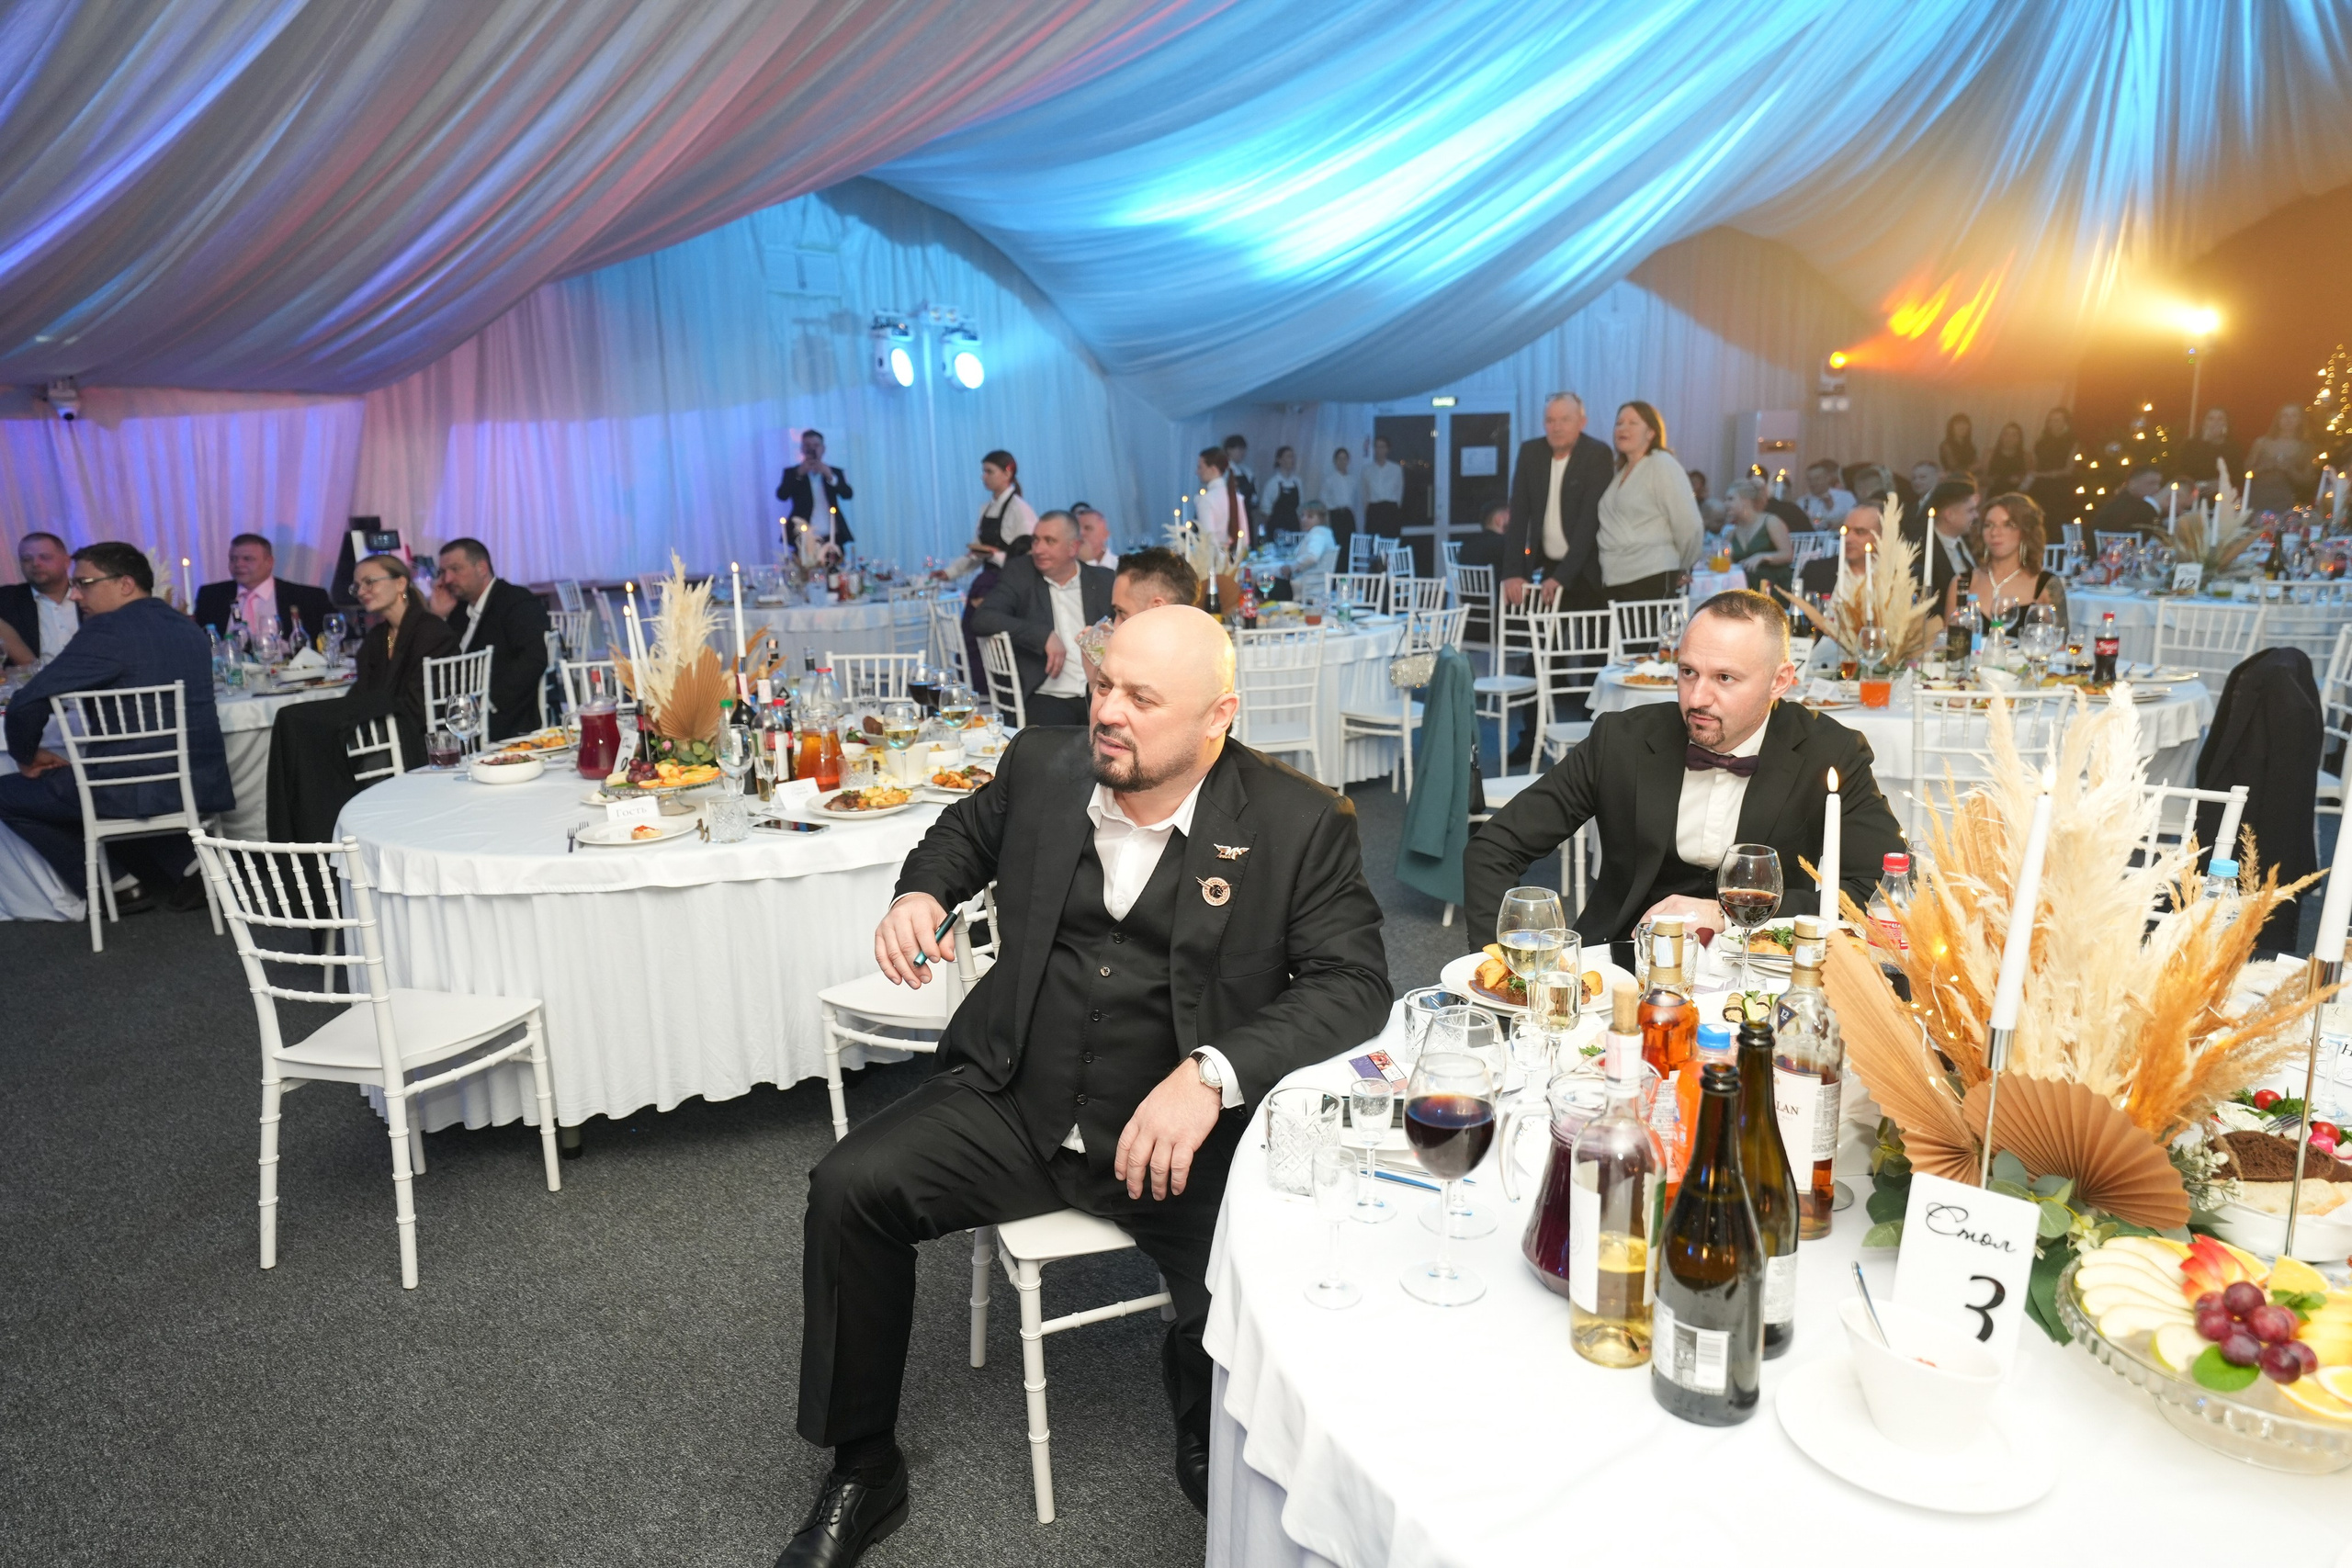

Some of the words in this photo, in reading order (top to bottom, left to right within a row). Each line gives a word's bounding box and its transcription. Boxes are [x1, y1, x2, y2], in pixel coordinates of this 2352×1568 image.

[616, 807, 648, 818] Гость
[1780, 1009, 1790, 1021] 12
[1775, 1100, 1801, 1116] LAN
[1926, 1201, 2017, 1253] Стол
[1964, 1275, 2006, 1343] 3
